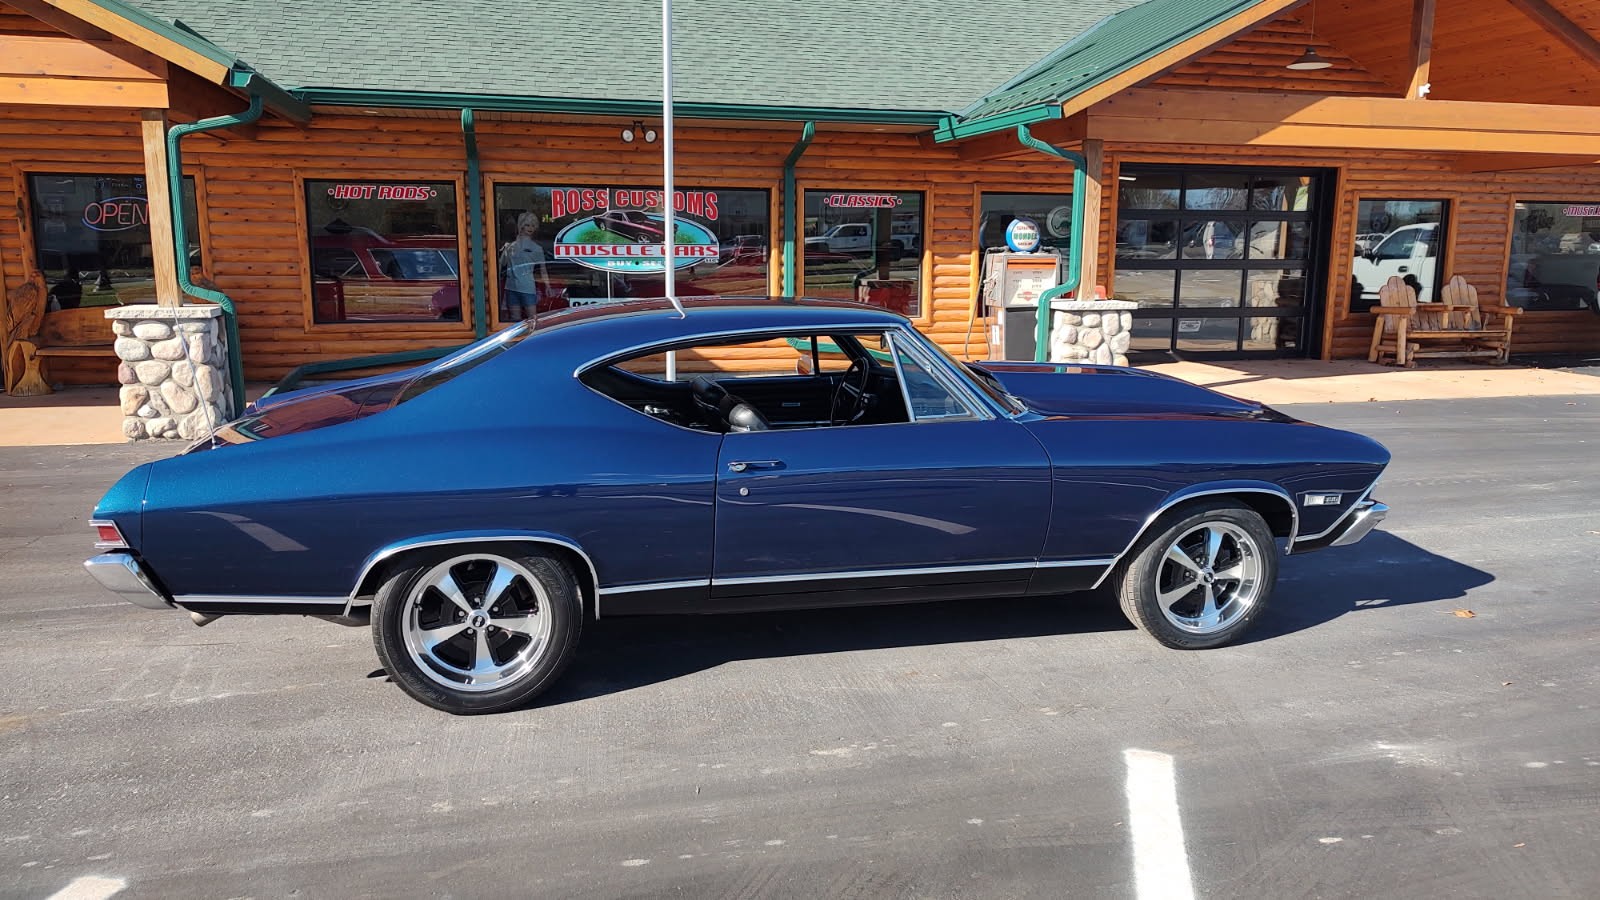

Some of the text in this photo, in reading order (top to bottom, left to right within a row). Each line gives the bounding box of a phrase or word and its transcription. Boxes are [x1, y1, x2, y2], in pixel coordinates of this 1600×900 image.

[335, 185, 430, 200] HOT RODS
[551, 188, 609, 219] ROSS
[829, 195, 897, 208] CLASSICS
[84, 202, 149, 224] OPEN
[555, 245, 654, 256] MUSCLE
